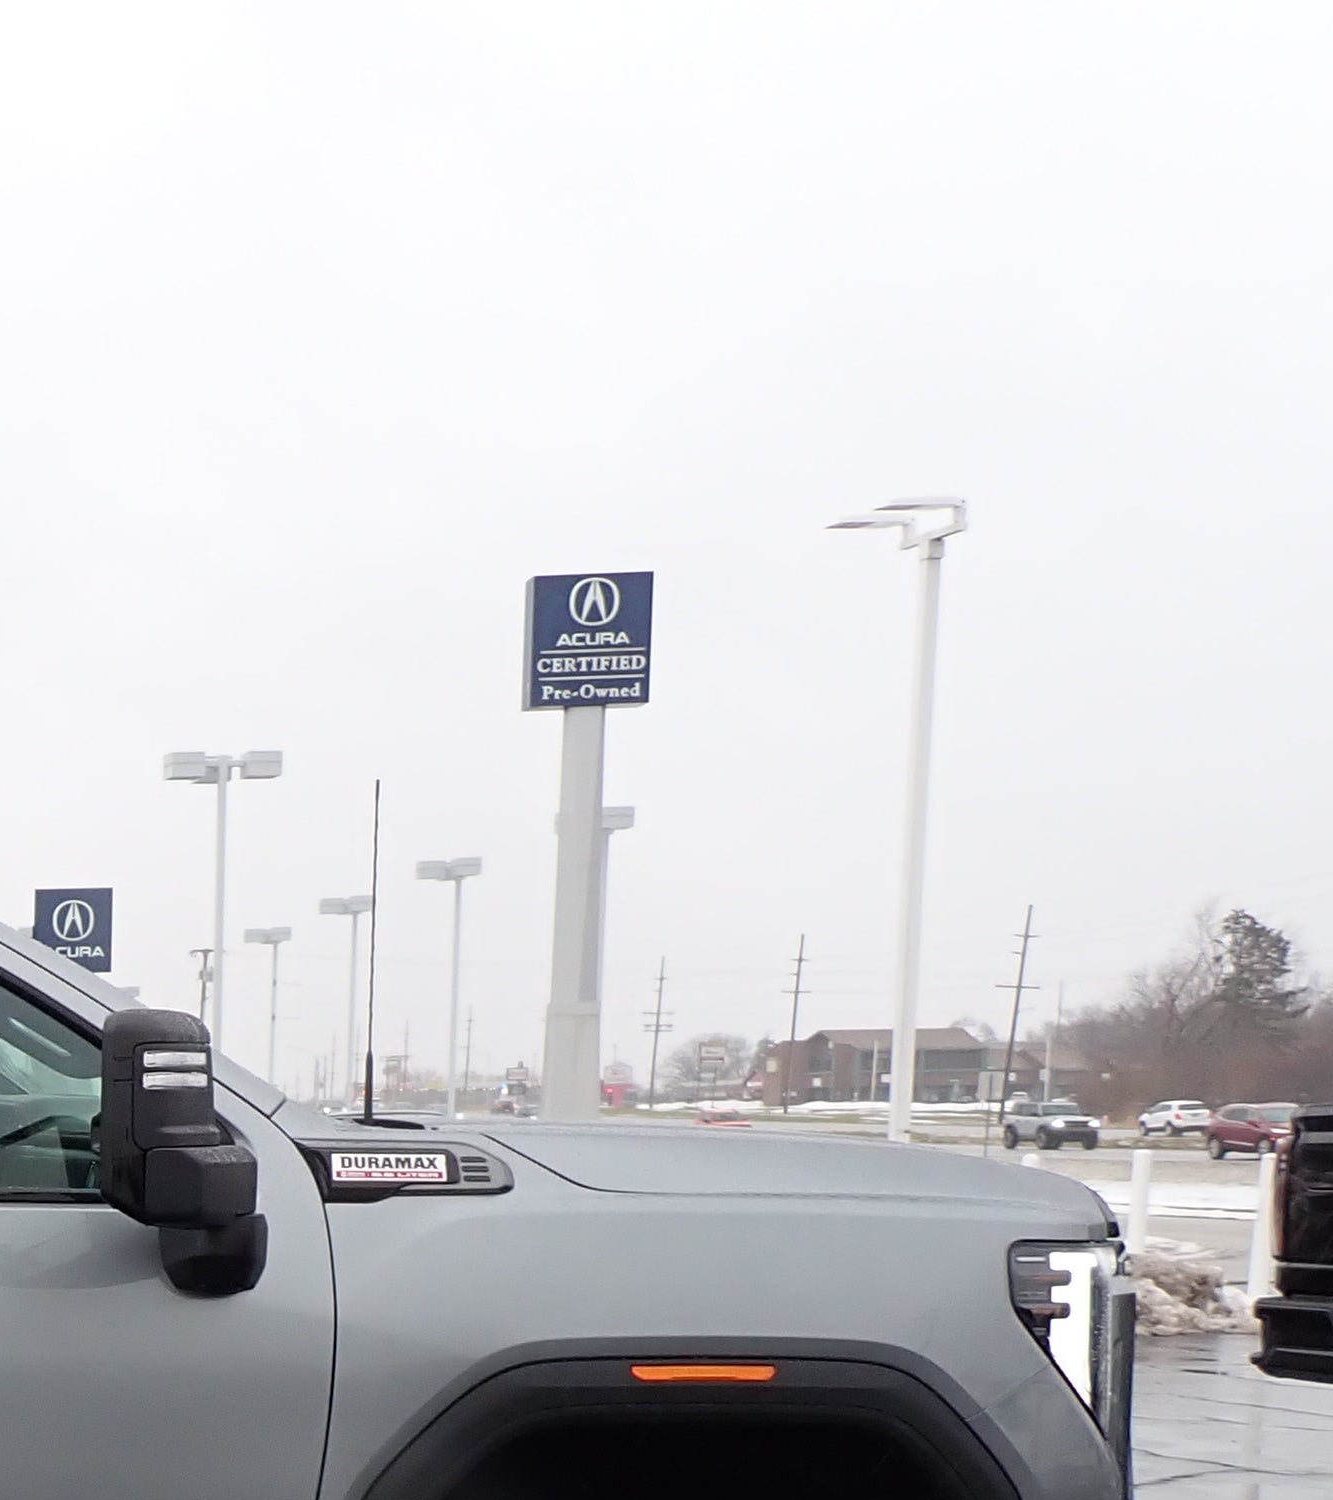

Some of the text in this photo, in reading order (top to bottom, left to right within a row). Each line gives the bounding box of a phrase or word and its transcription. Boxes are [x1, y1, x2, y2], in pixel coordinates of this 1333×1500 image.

[556, 631, 631, 647] ACURA
[536, 655, 647, 674] CERTIFIED
[541, 682, 641, 700] Pre-Owned
[55, 946, 105, 958] CURA
[340, 1156, 438, 1169] DURAMAX
